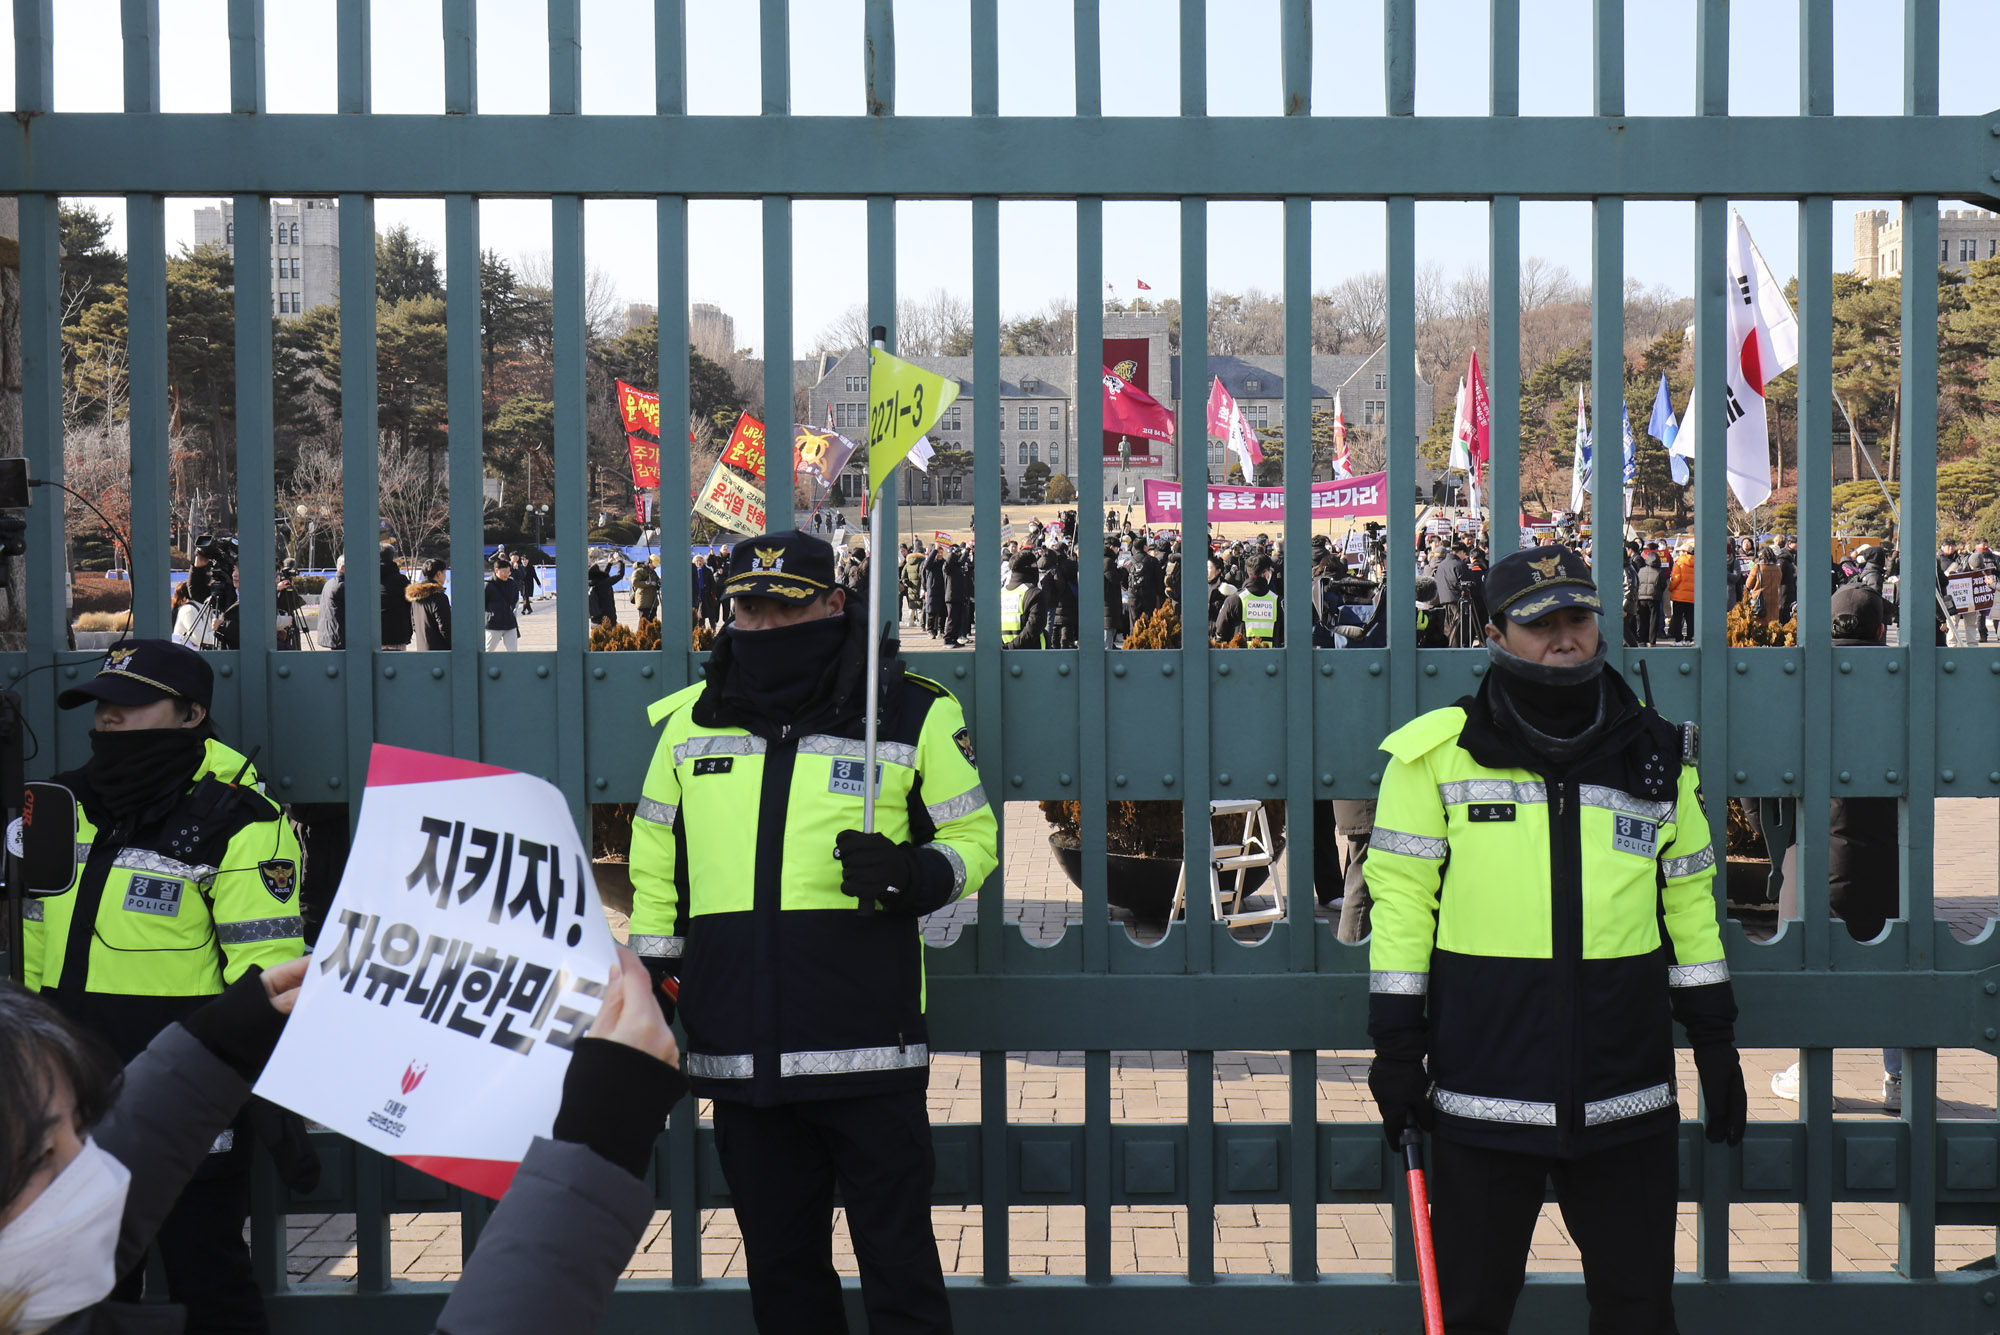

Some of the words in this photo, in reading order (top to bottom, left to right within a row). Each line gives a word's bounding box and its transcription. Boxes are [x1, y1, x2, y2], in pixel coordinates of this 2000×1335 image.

[870, 383, 923, 447] 22기-3
[742, 424, 765, 449] 내란
[710, 482, 744, 516] 윤석열
[746, 503, 766, 530] 탄핵
[1218, 491, 1256, 510] 옹호
[1618, 817, 1654, 841] 경찰
[1617, 838, 1652, 853] POLICE
[135, 878, 177, 900] 경찰
[405, 816, 586, 948] 지키자!
[128, 899, 173, 911] POLICE
